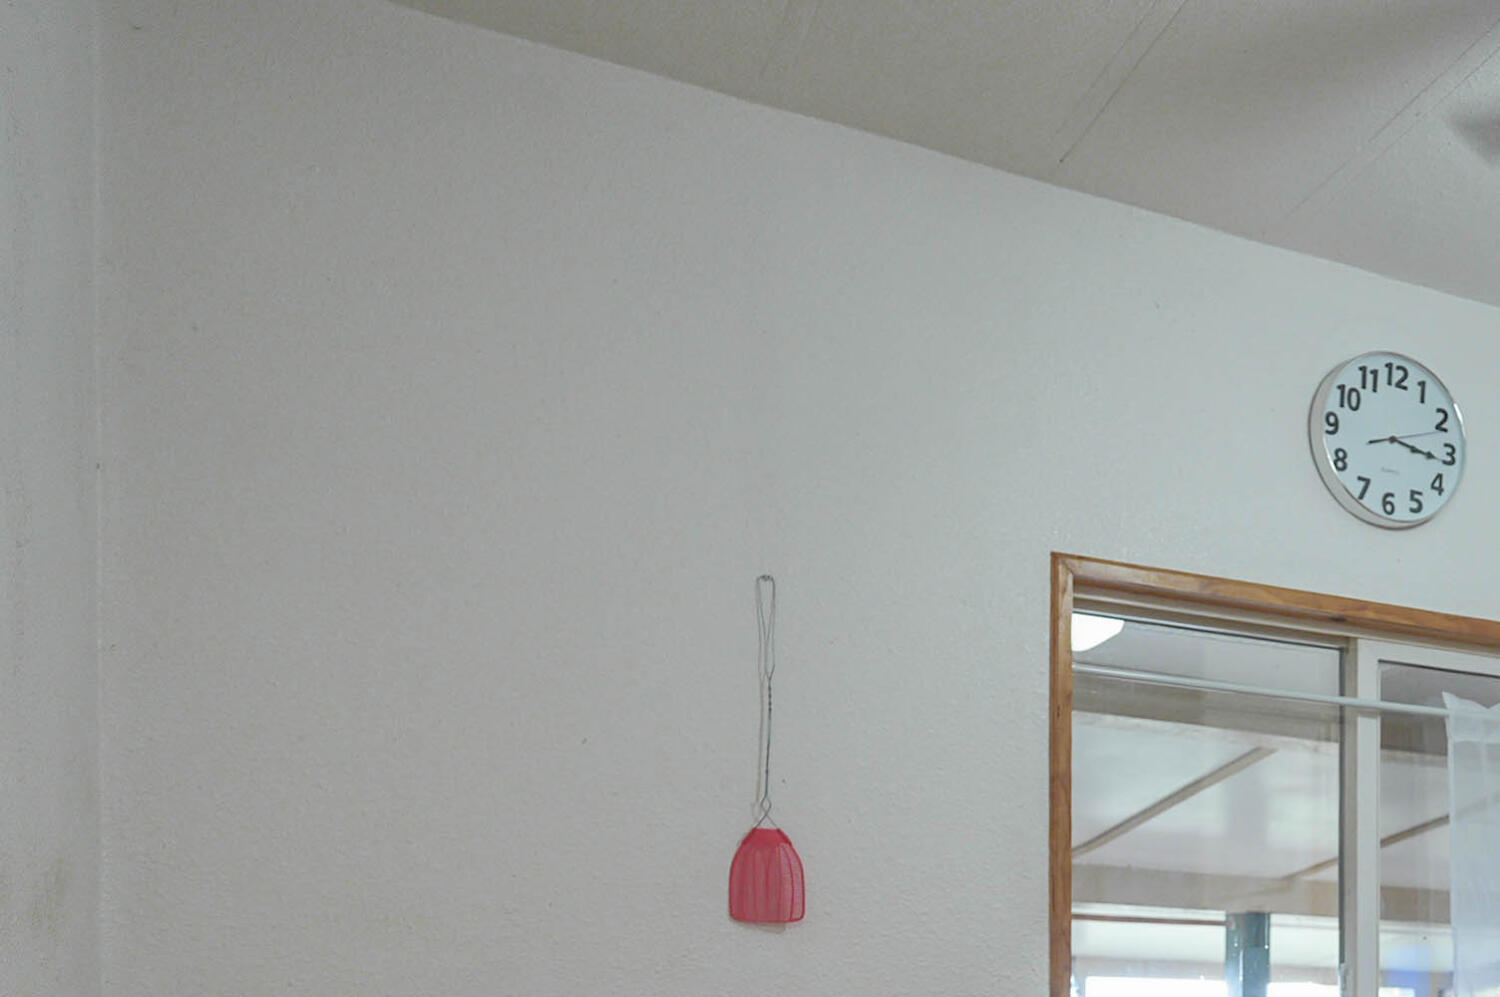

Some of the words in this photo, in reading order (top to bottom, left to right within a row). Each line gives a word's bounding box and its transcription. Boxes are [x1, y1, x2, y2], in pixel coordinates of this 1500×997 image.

[1358, 365, 1379, 393] 11
[1384, 362, 1409, 391] 12
[1336, 384, 1361, 412] 10
[1417, 380, 1426, 404] 1
[1325, 411, 1339, 435] 9
[1434, 408, 1449, 433] 2
[1333, 447, 1348, 472] 8
[1442, 443, 1456, 466] 3
[1357, 475, 1372, 500] 7
[1430, 473, 1444, 496] 4
[1382, 492, 1395, 515] 6
[1409, 489, 1423, 514] 5
